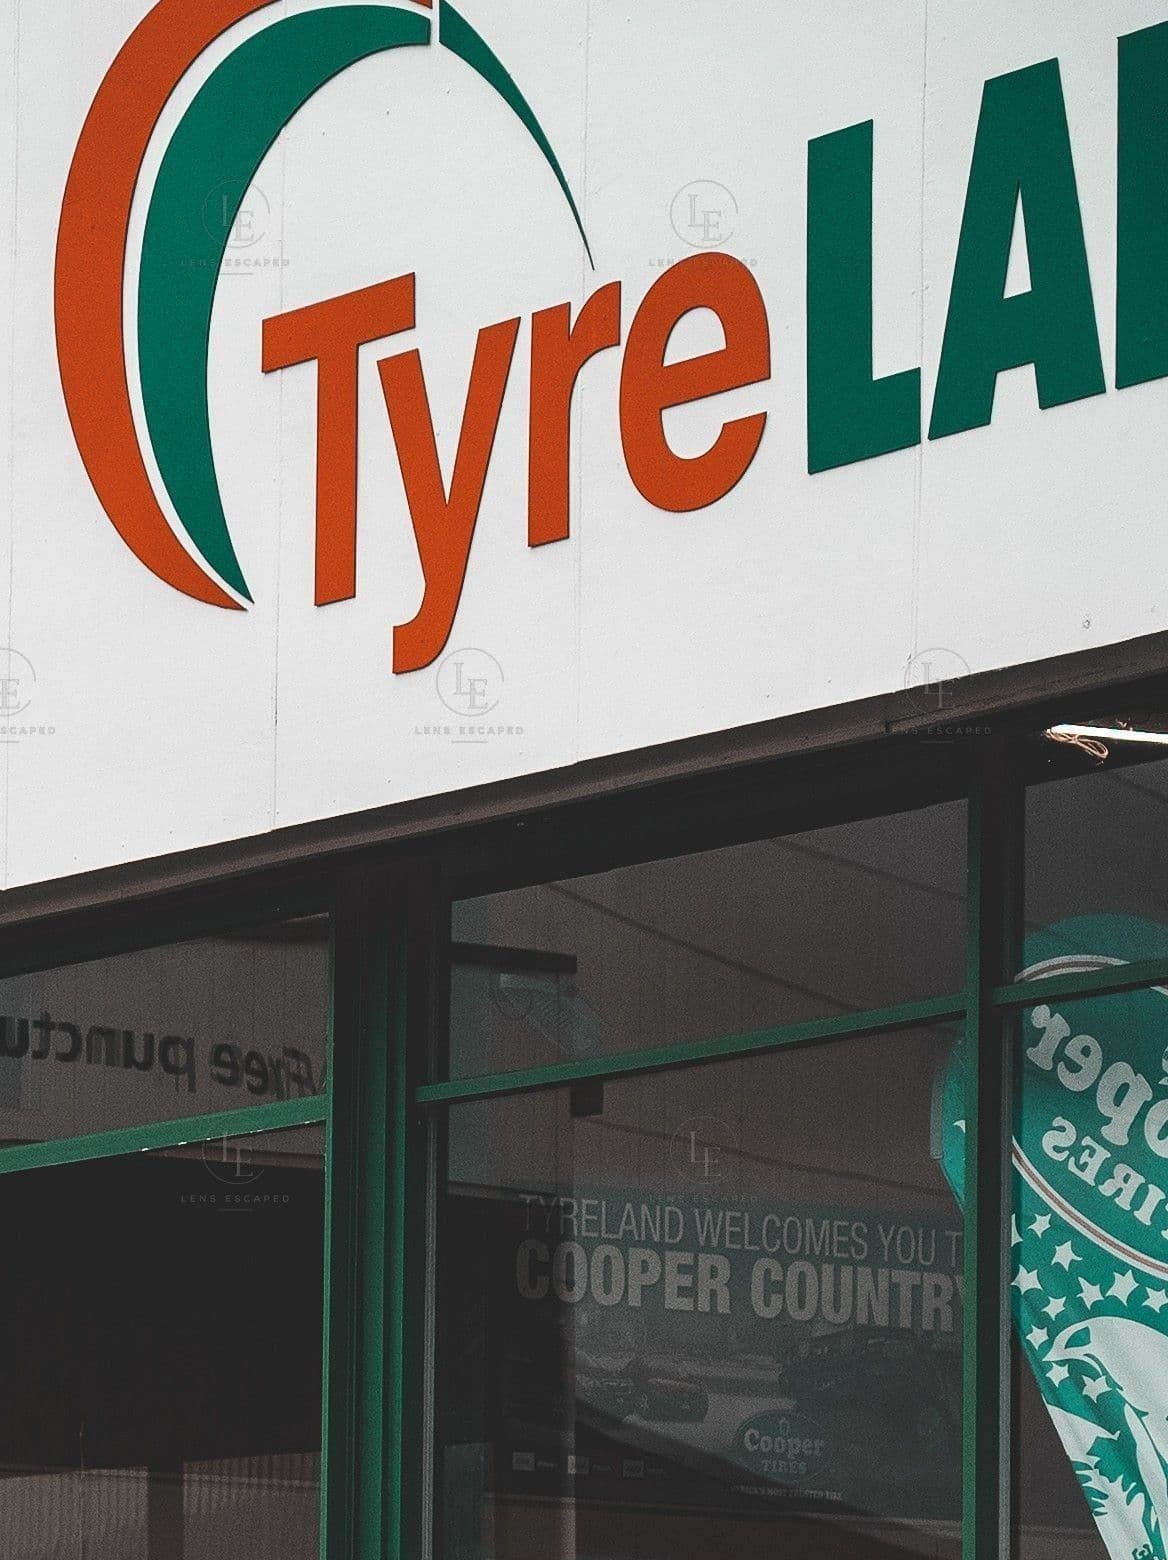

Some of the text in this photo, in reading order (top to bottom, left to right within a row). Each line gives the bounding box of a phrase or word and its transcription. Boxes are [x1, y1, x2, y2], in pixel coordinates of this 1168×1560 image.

[262, 251, 770, 674] Tyre
[518, 1194, 683, 1244] TYRELAND
[694, 1208, 868, 1260] WELCOMES
[878, 1223, 936, 1265] YOU
[516, 1239, 731, 1314] COOPER
[744, 1428, 825, 1458] Cooper
